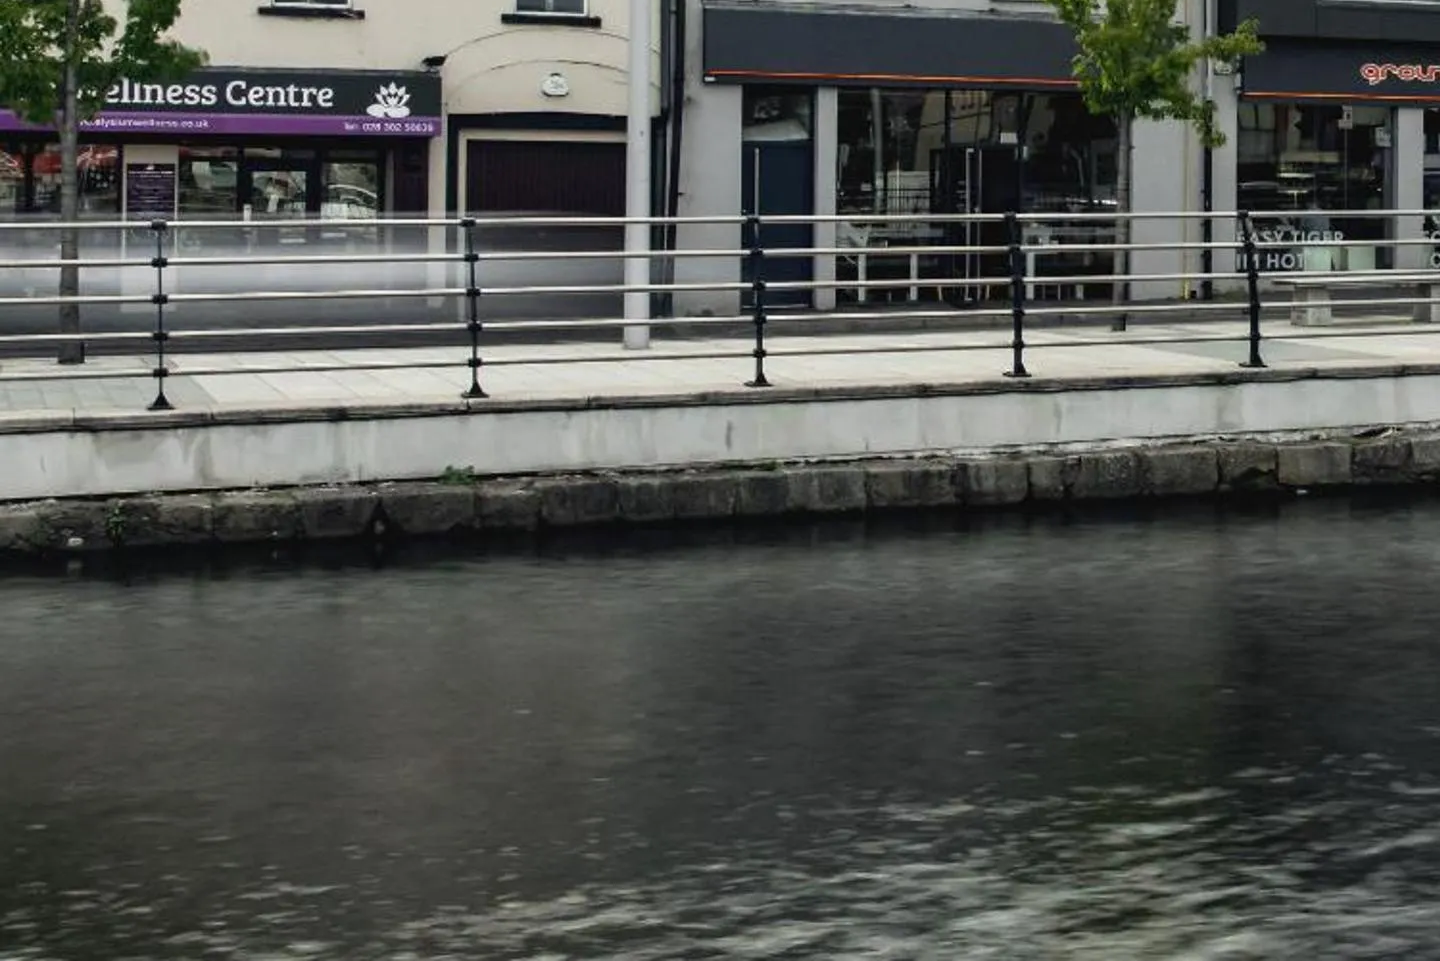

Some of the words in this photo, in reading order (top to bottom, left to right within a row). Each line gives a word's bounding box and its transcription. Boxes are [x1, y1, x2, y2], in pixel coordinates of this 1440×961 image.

[77, 76, 218, 106] ellness
[225, 80, 334, 108] Centre
[1290, 230, 1344, 243] TIGER
